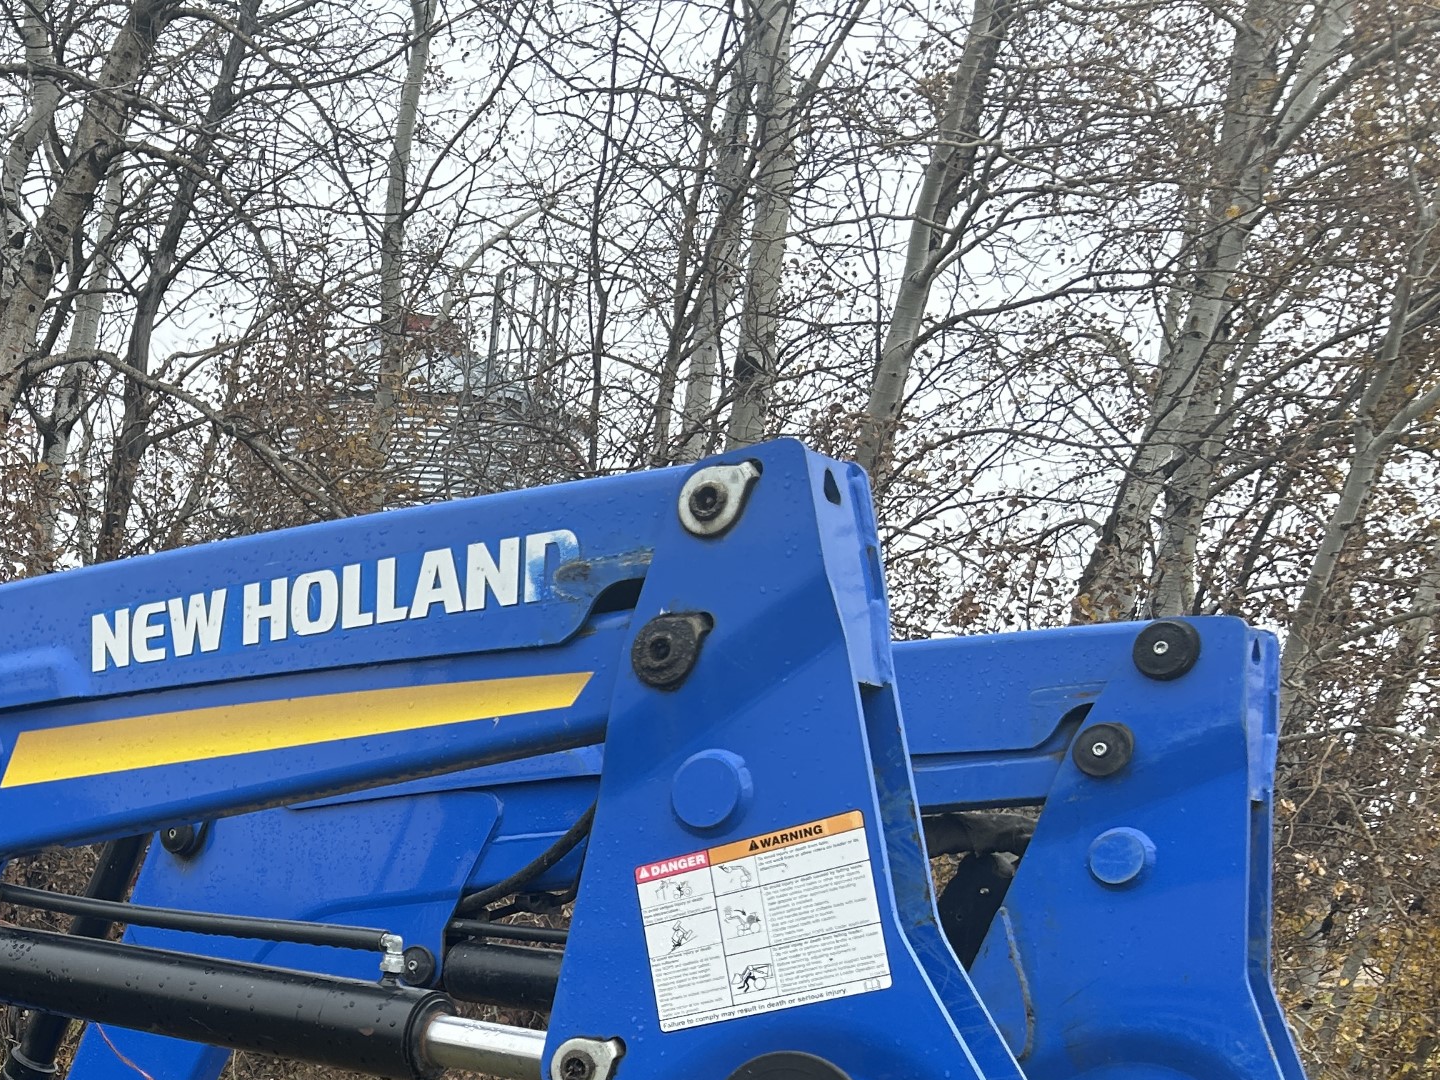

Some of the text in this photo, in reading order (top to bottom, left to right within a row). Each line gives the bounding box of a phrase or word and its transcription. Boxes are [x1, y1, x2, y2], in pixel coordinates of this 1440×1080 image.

[91, 529, 581, 673] NEW HOLLAND
[759, 825, 823, 849] WARNING
[651, 855, 706, 877] DANGER
[663, 1020, 686, 1030] Failure
[695, 1014, 720, 1024] comply
[721, 1010, 736, 1019] may
[737, 1006, 757, 1015] result
[767, 1000, 786, 1009] death
[798, 992, 824, 1003] serious
